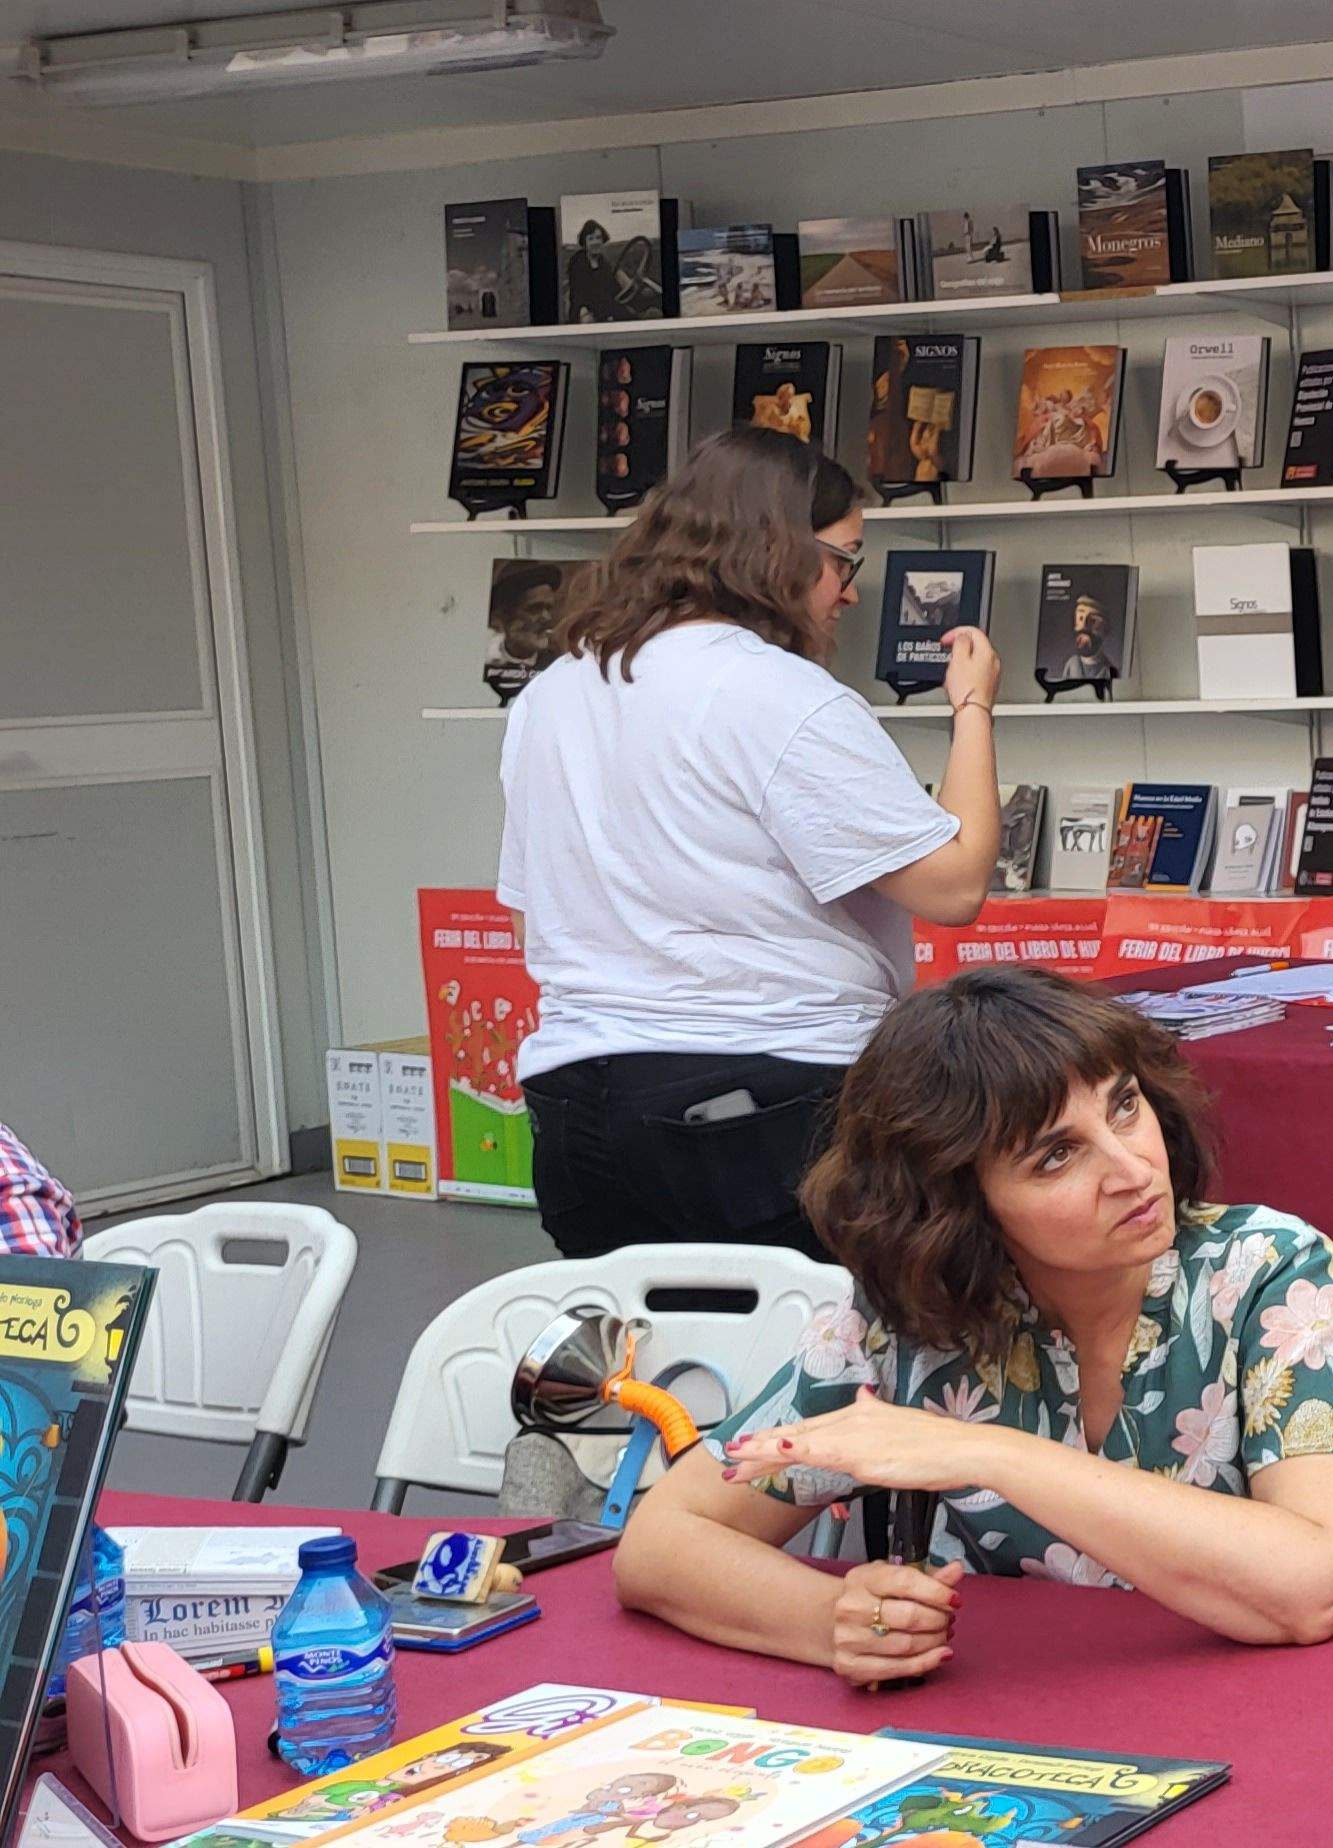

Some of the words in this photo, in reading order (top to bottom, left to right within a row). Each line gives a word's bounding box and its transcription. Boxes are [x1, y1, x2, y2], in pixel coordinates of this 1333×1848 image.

[1087, 234, 1162, 253] Monegros
[1215, 235, 1265, 250] Mediano
[914, 345, 959, 358] SIGNOS
[1190, 342, 1234, 355] Orwell
[897, 641, 914, 653] LOS
[957, 942, 992, 963] FERIA
[994, 941, 1019, 961] DEL
[1020, 940, 1059, 960] LIBRO
[1118, 938, 1158, 960] FERIA
[1158, 941, 1182, 962] DEL
[1184, 944, 1225, 963] LIBRO
[140, 1596, 250, 1625] Lorem
[163, 1627, 189, 1640] hac
[194, 1619, 260, 1636] habitasse
[628, 1728, 845, 1775] BONGO
